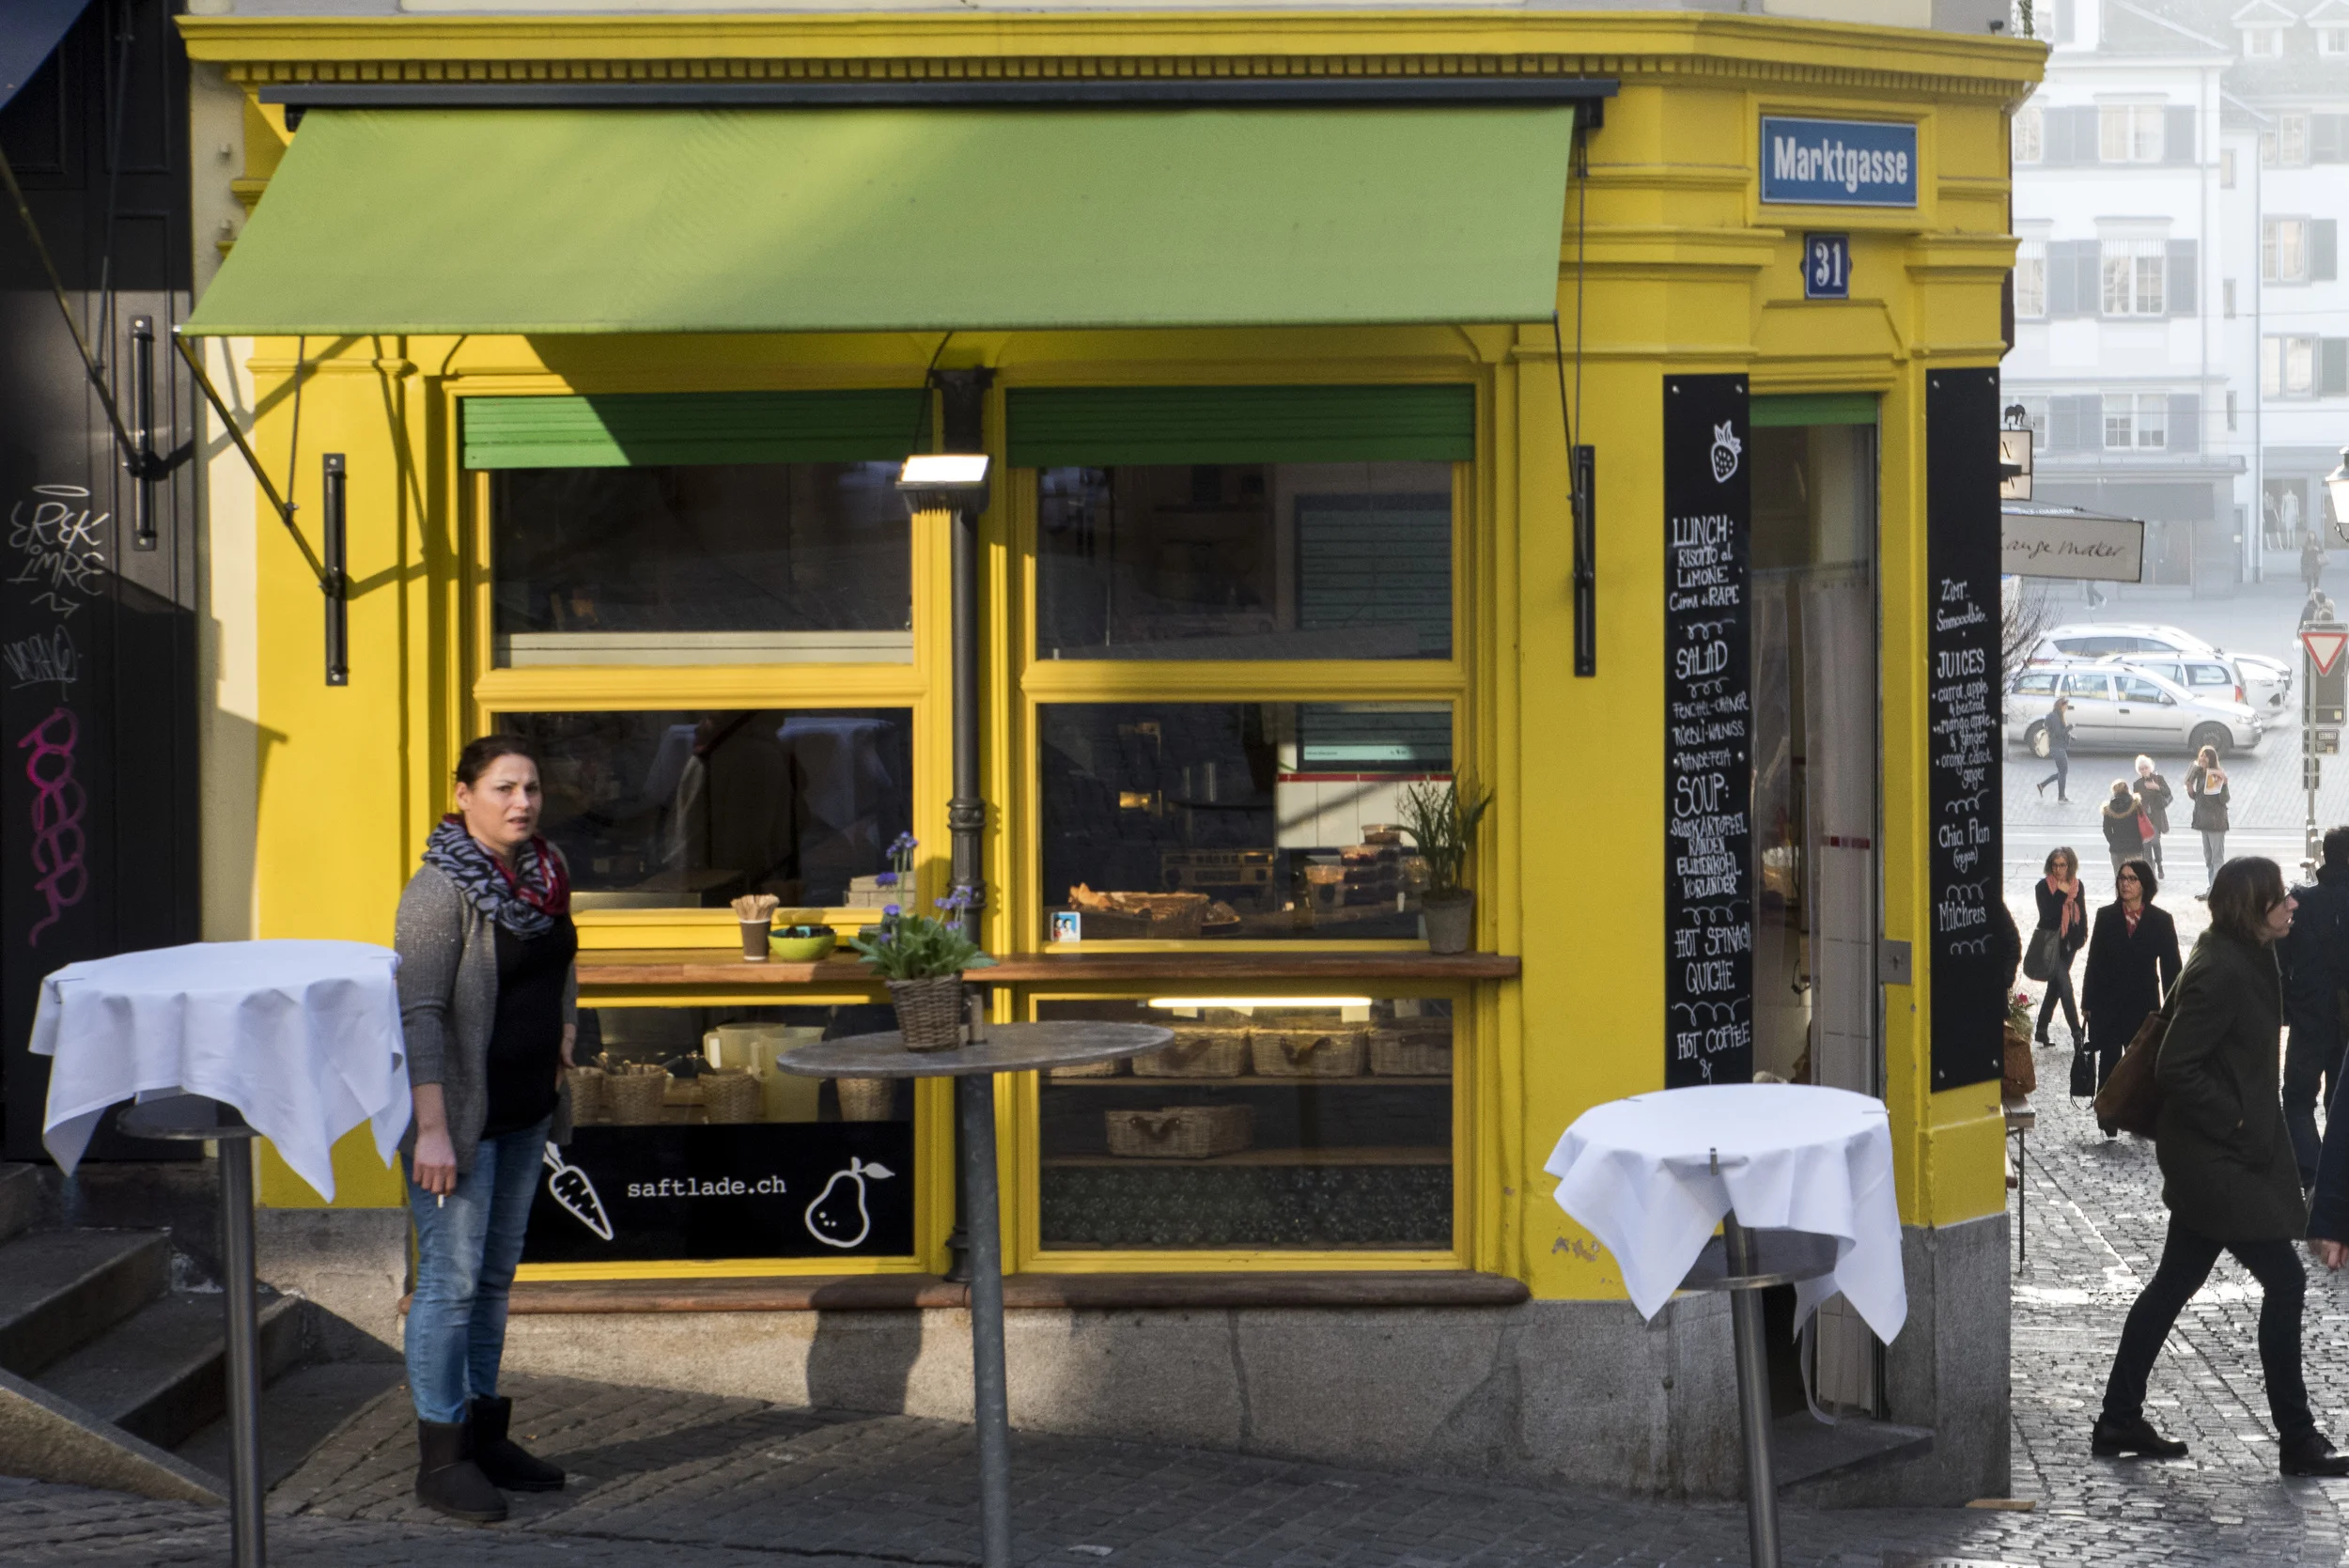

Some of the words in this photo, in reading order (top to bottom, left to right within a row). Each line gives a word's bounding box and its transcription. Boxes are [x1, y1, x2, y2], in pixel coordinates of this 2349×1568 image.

[1774, 136, 1908, 194] Marktgasse
[1814, 241, 1843, 287] 31
[1672, 514, 1734, 548] LUNCH:
[2000, 533, 2053, 560] ange
[1674, 640, 1729, 680] SALAD
[1937, 647, 1985, 678] JUICES
[1674, 772, 1729, 817] SOUP:
[1674, 927, 1701, 958] HOT
[1686, 960, 1735, 996] QUICHE
[627, 1175, 786, 1199] saftlade.ch
